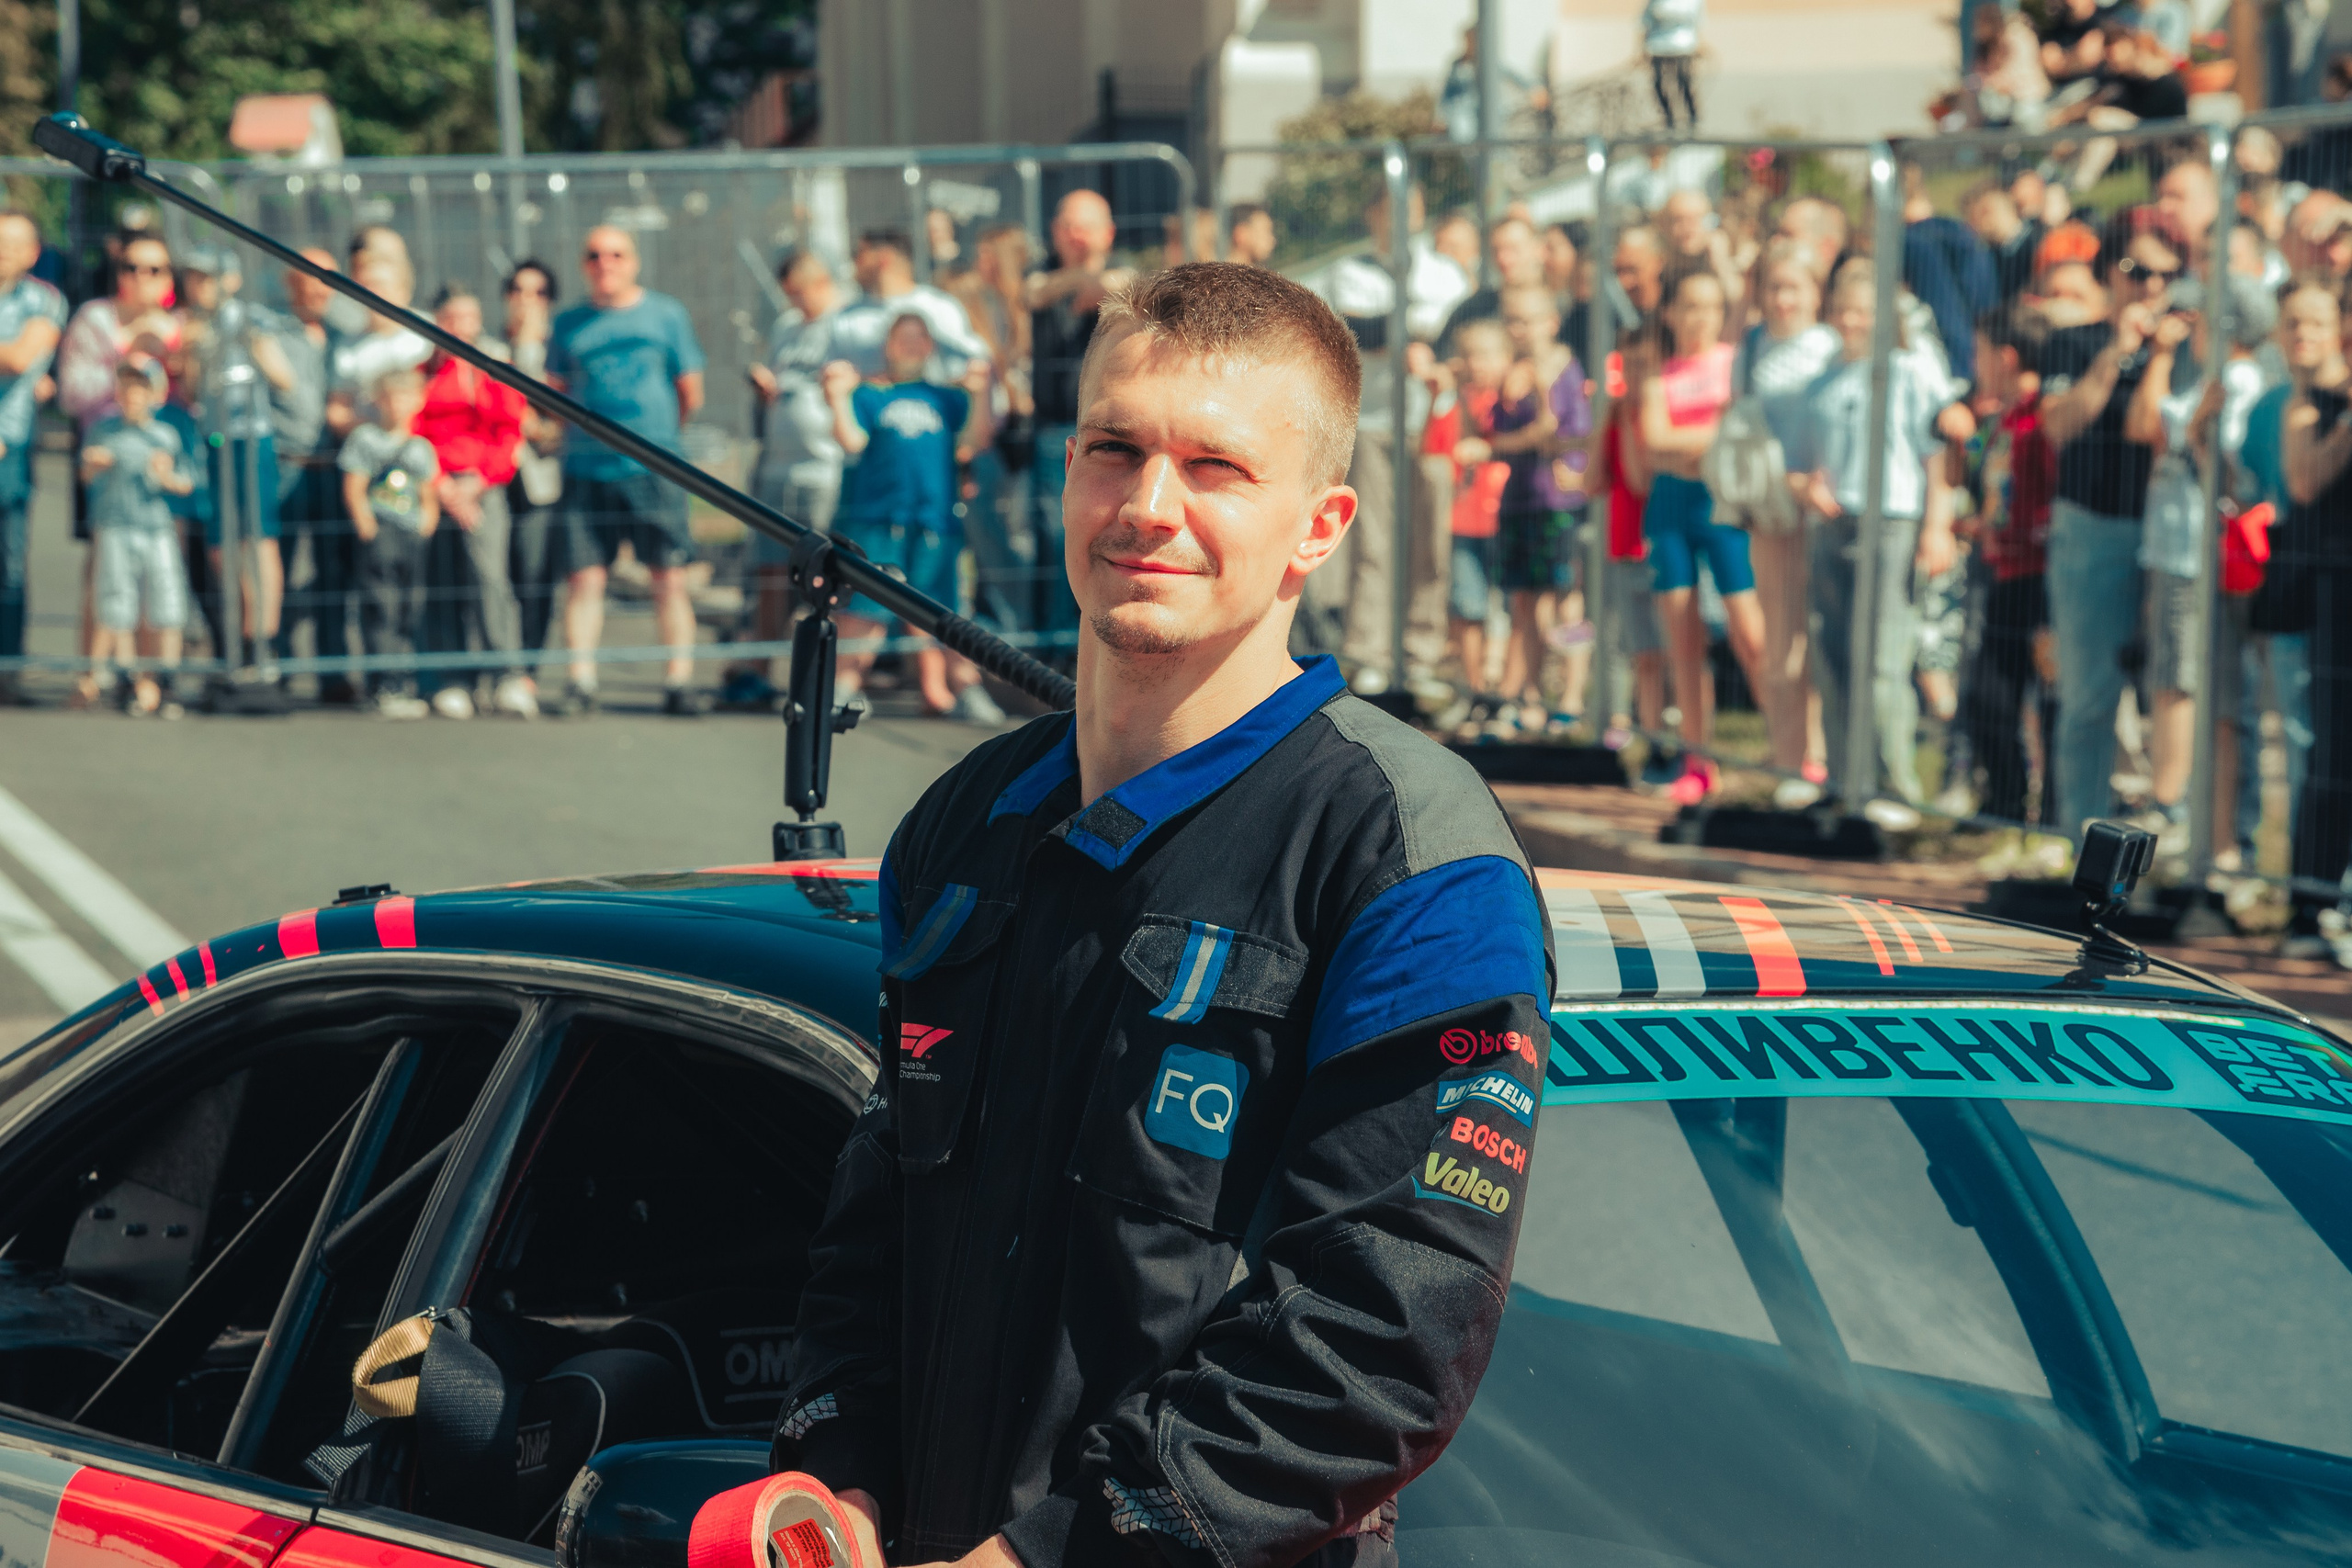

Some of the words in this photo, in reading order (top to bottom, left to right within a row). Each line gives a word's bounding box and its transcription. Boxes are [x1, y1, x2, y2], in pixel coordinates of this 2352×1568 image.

[899, 1069, 941, 1082] Championship
[916, 1061, 926, 1071] One
[1547, 1016, 2175, 1091] ШЛИВЕНКО
[2187, 1030, 2341, 1078] BET
[1155, 1067, 1234, 1134] FQ
[1442, 1075, 1533, 1115] MICHELIN
[1451, 1116, 1527, 1174] BOSCH
[1424, 1152, 1510, 1213] Valeo
[724, 1339, 794, 1385] OM
